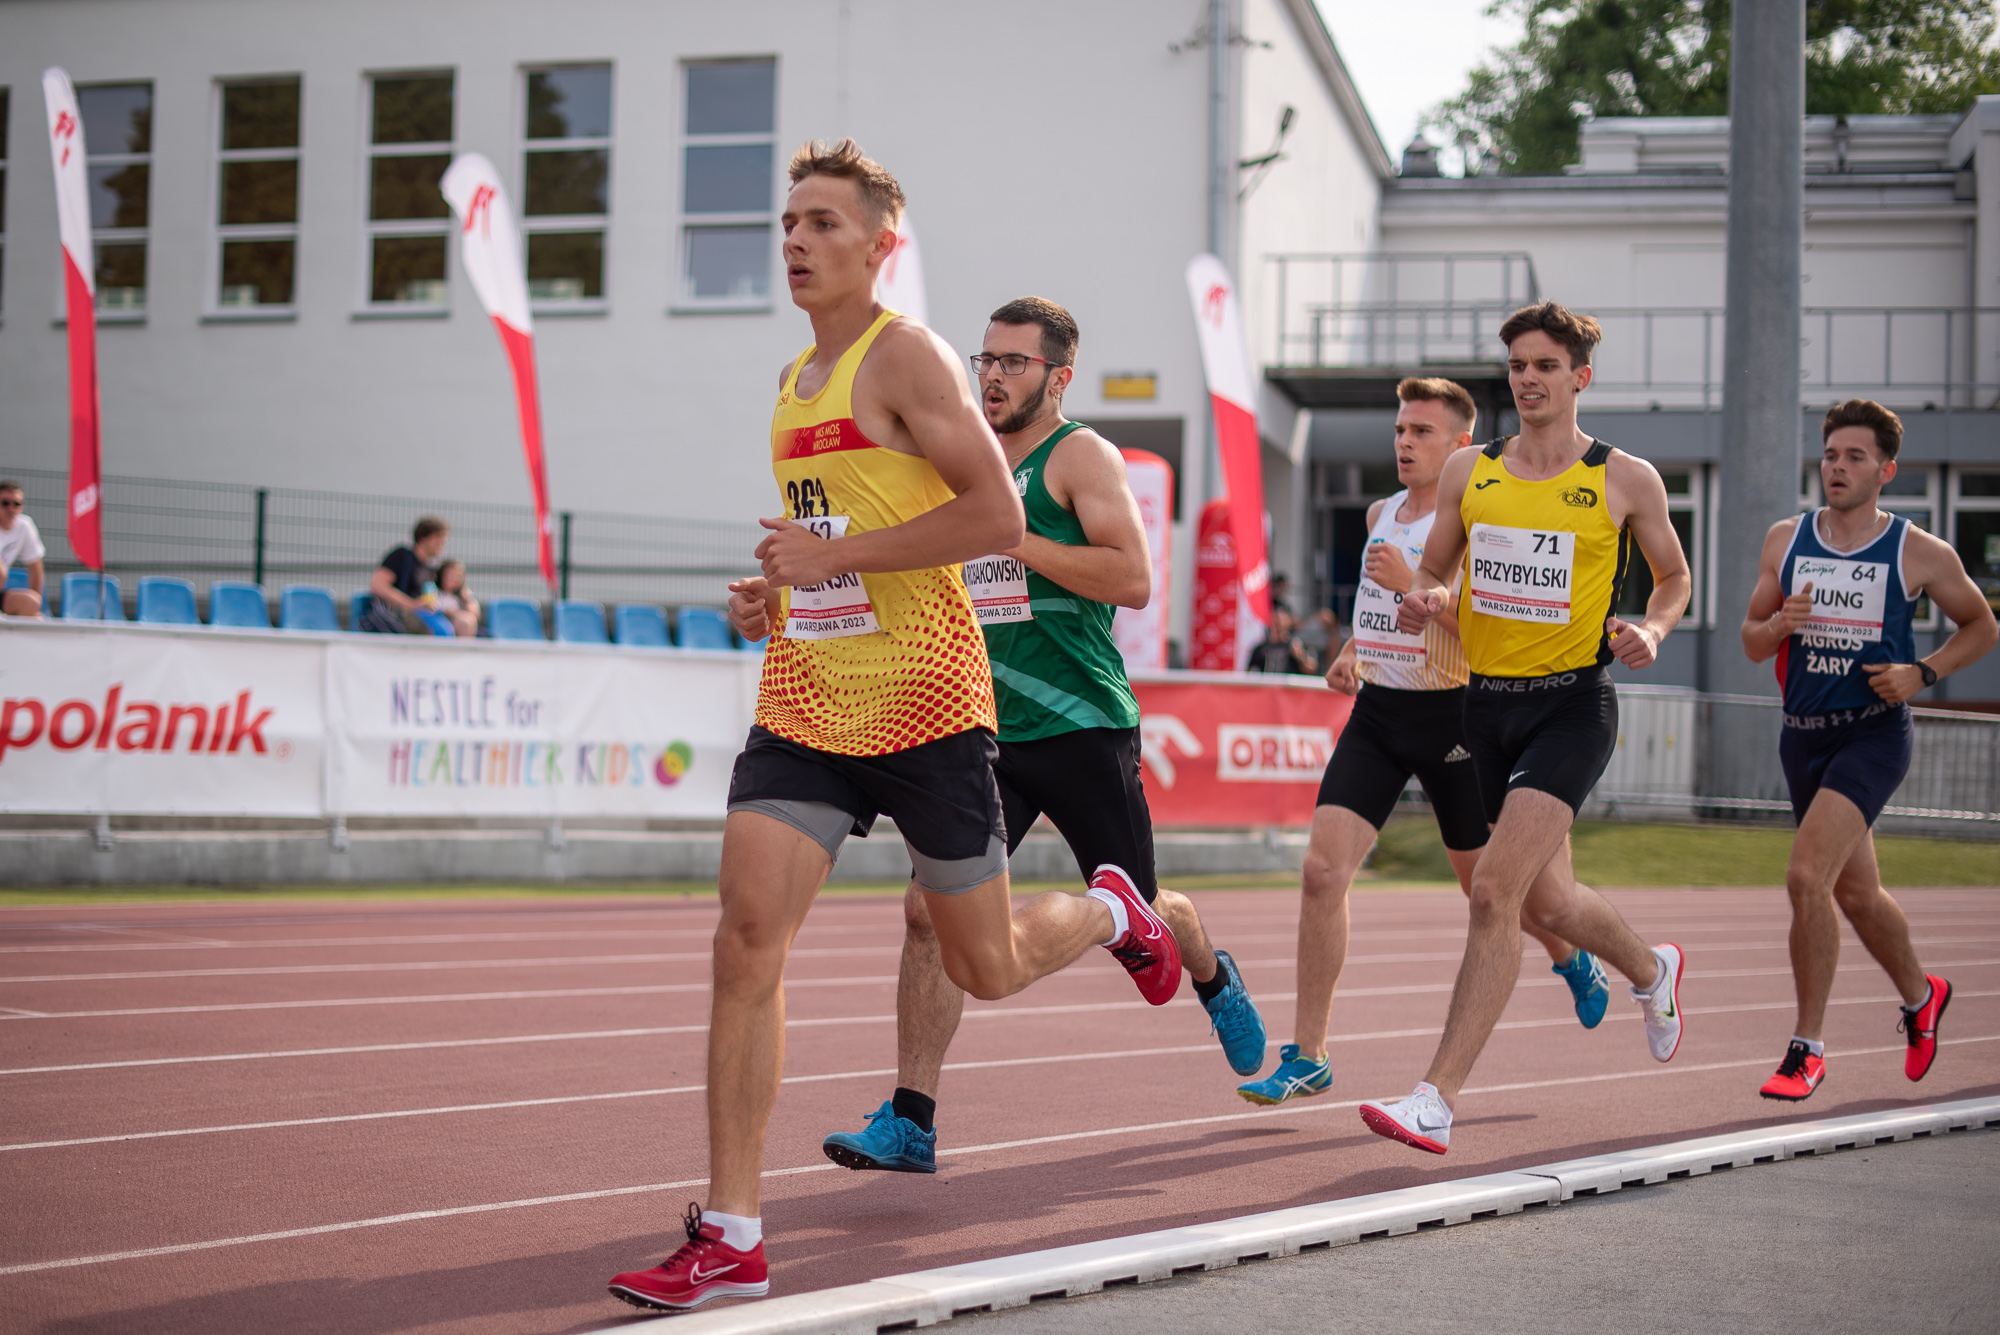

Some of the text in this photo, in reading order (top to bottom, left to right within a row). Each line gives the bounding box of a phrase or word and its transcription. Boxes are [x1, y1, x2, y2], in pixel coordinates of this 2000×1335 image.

[815, 423, 840, 439] MKS MOS
[813, 436, 841, 451] WROCŁAW
[787, 477, 830, 520] 363
[1532, 533, 1560, 555] 71
[1474, 558, 1567, 589] PRZYBYLSKI
[1851, 565, 1877, 582] 64
[1813, 588, 1864, 609] JUNG
[1001, 606, 1022, 616] 2023
[1479, 599, 1559, 618] WARSZAWA 2023
[796, 616, 866, 632] WARSZAWA 2023
[1851, 628, 1873, 637] 2023
[1801, 634, 1864, 652] AGROS
[1397, 654, 1416, 663] 2023
[1806, 650, 1855, 676] ŻARY
[1480, 673, 1578, 692] NIKE PRO
[391, 677, 543, 728] NESTLÉ for
[0, 681, 275, 767] polanik
[389, 739, 645, 788] HEALTHIER KIDS
